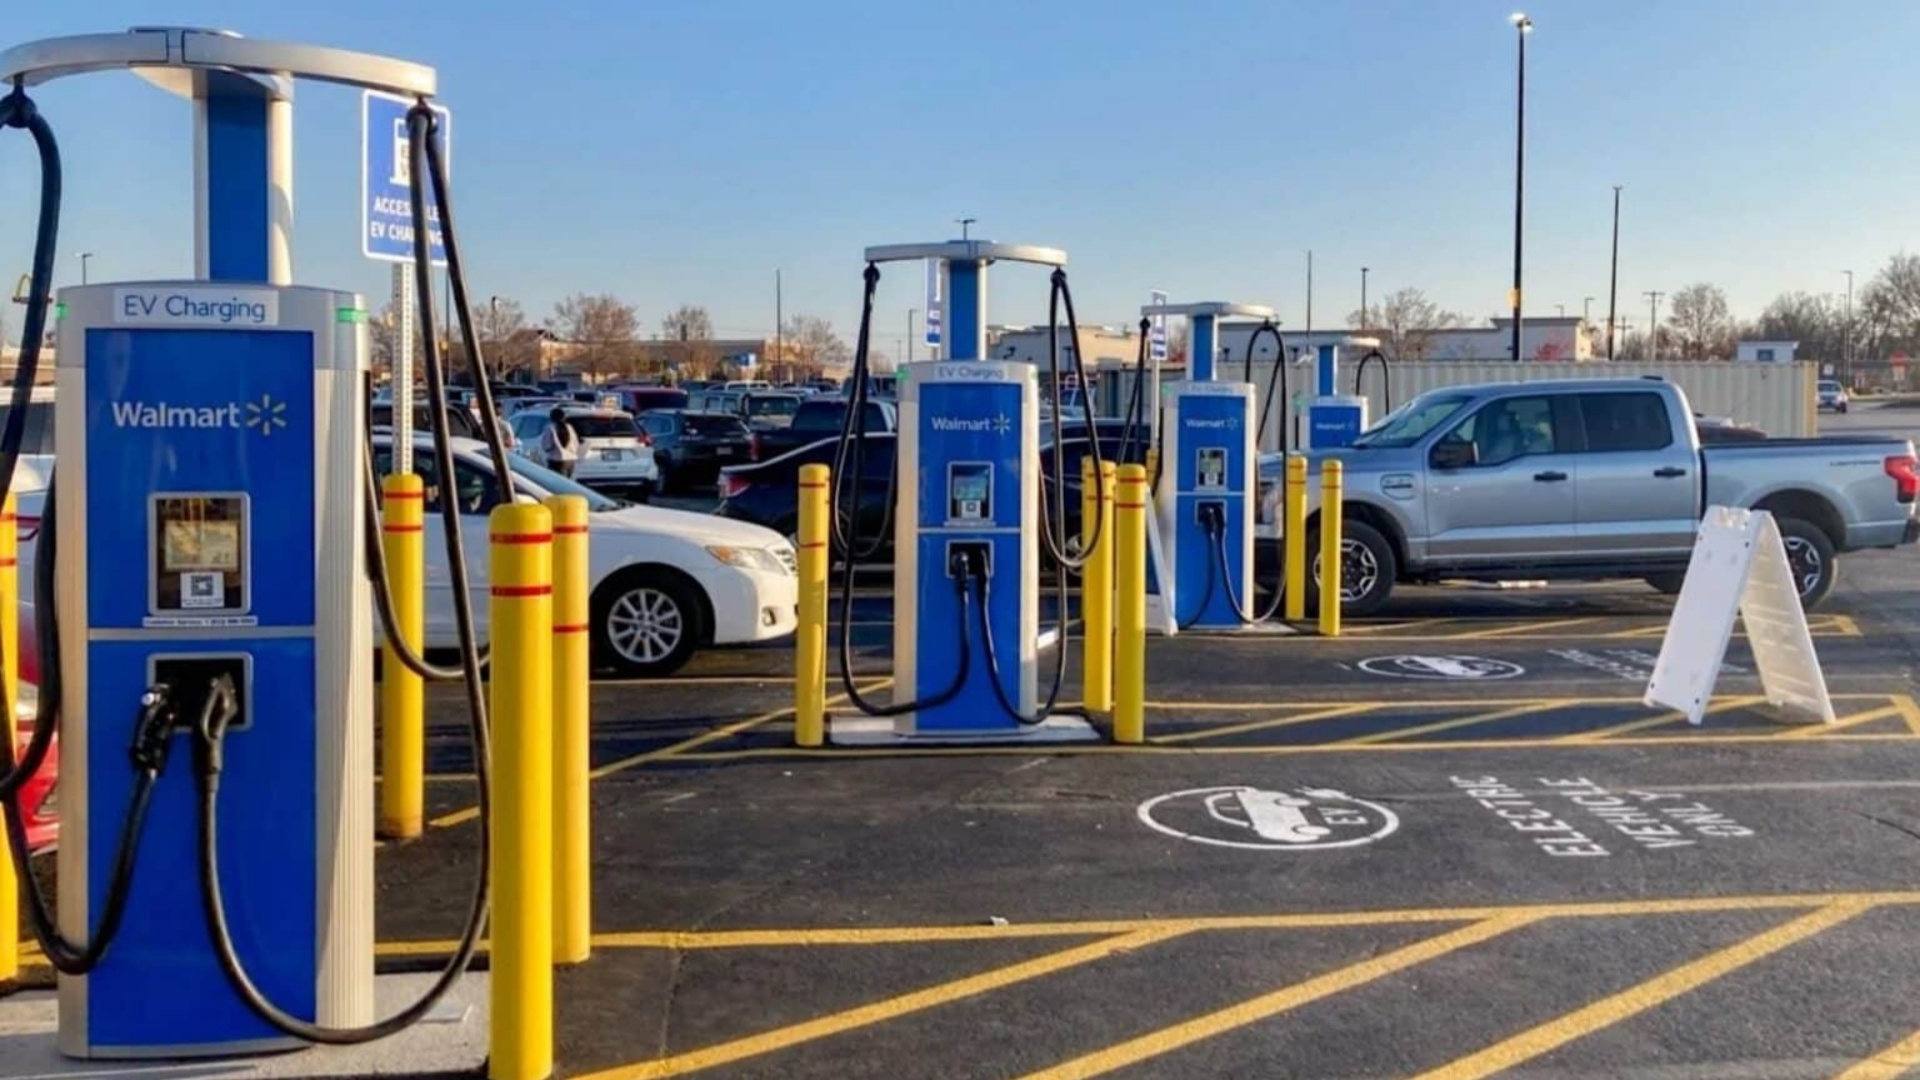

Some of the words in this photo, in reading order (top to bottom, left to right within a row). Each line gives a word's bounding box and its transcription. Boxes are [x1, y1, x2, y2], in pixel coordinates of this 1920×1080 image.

[370, 220, 386, 239] EV
[124, 295, 157, 316] EV
[165, 295, 265, 323] Charging
[940, 366, 956, 376] EV
[112, 402, 240, 428] Walmart
[931, 417, 991, 431] Walmart
[1450, 775, 1610, 856] ELECTRIC
[1535, 776, 1697, 848] VEHICLE
